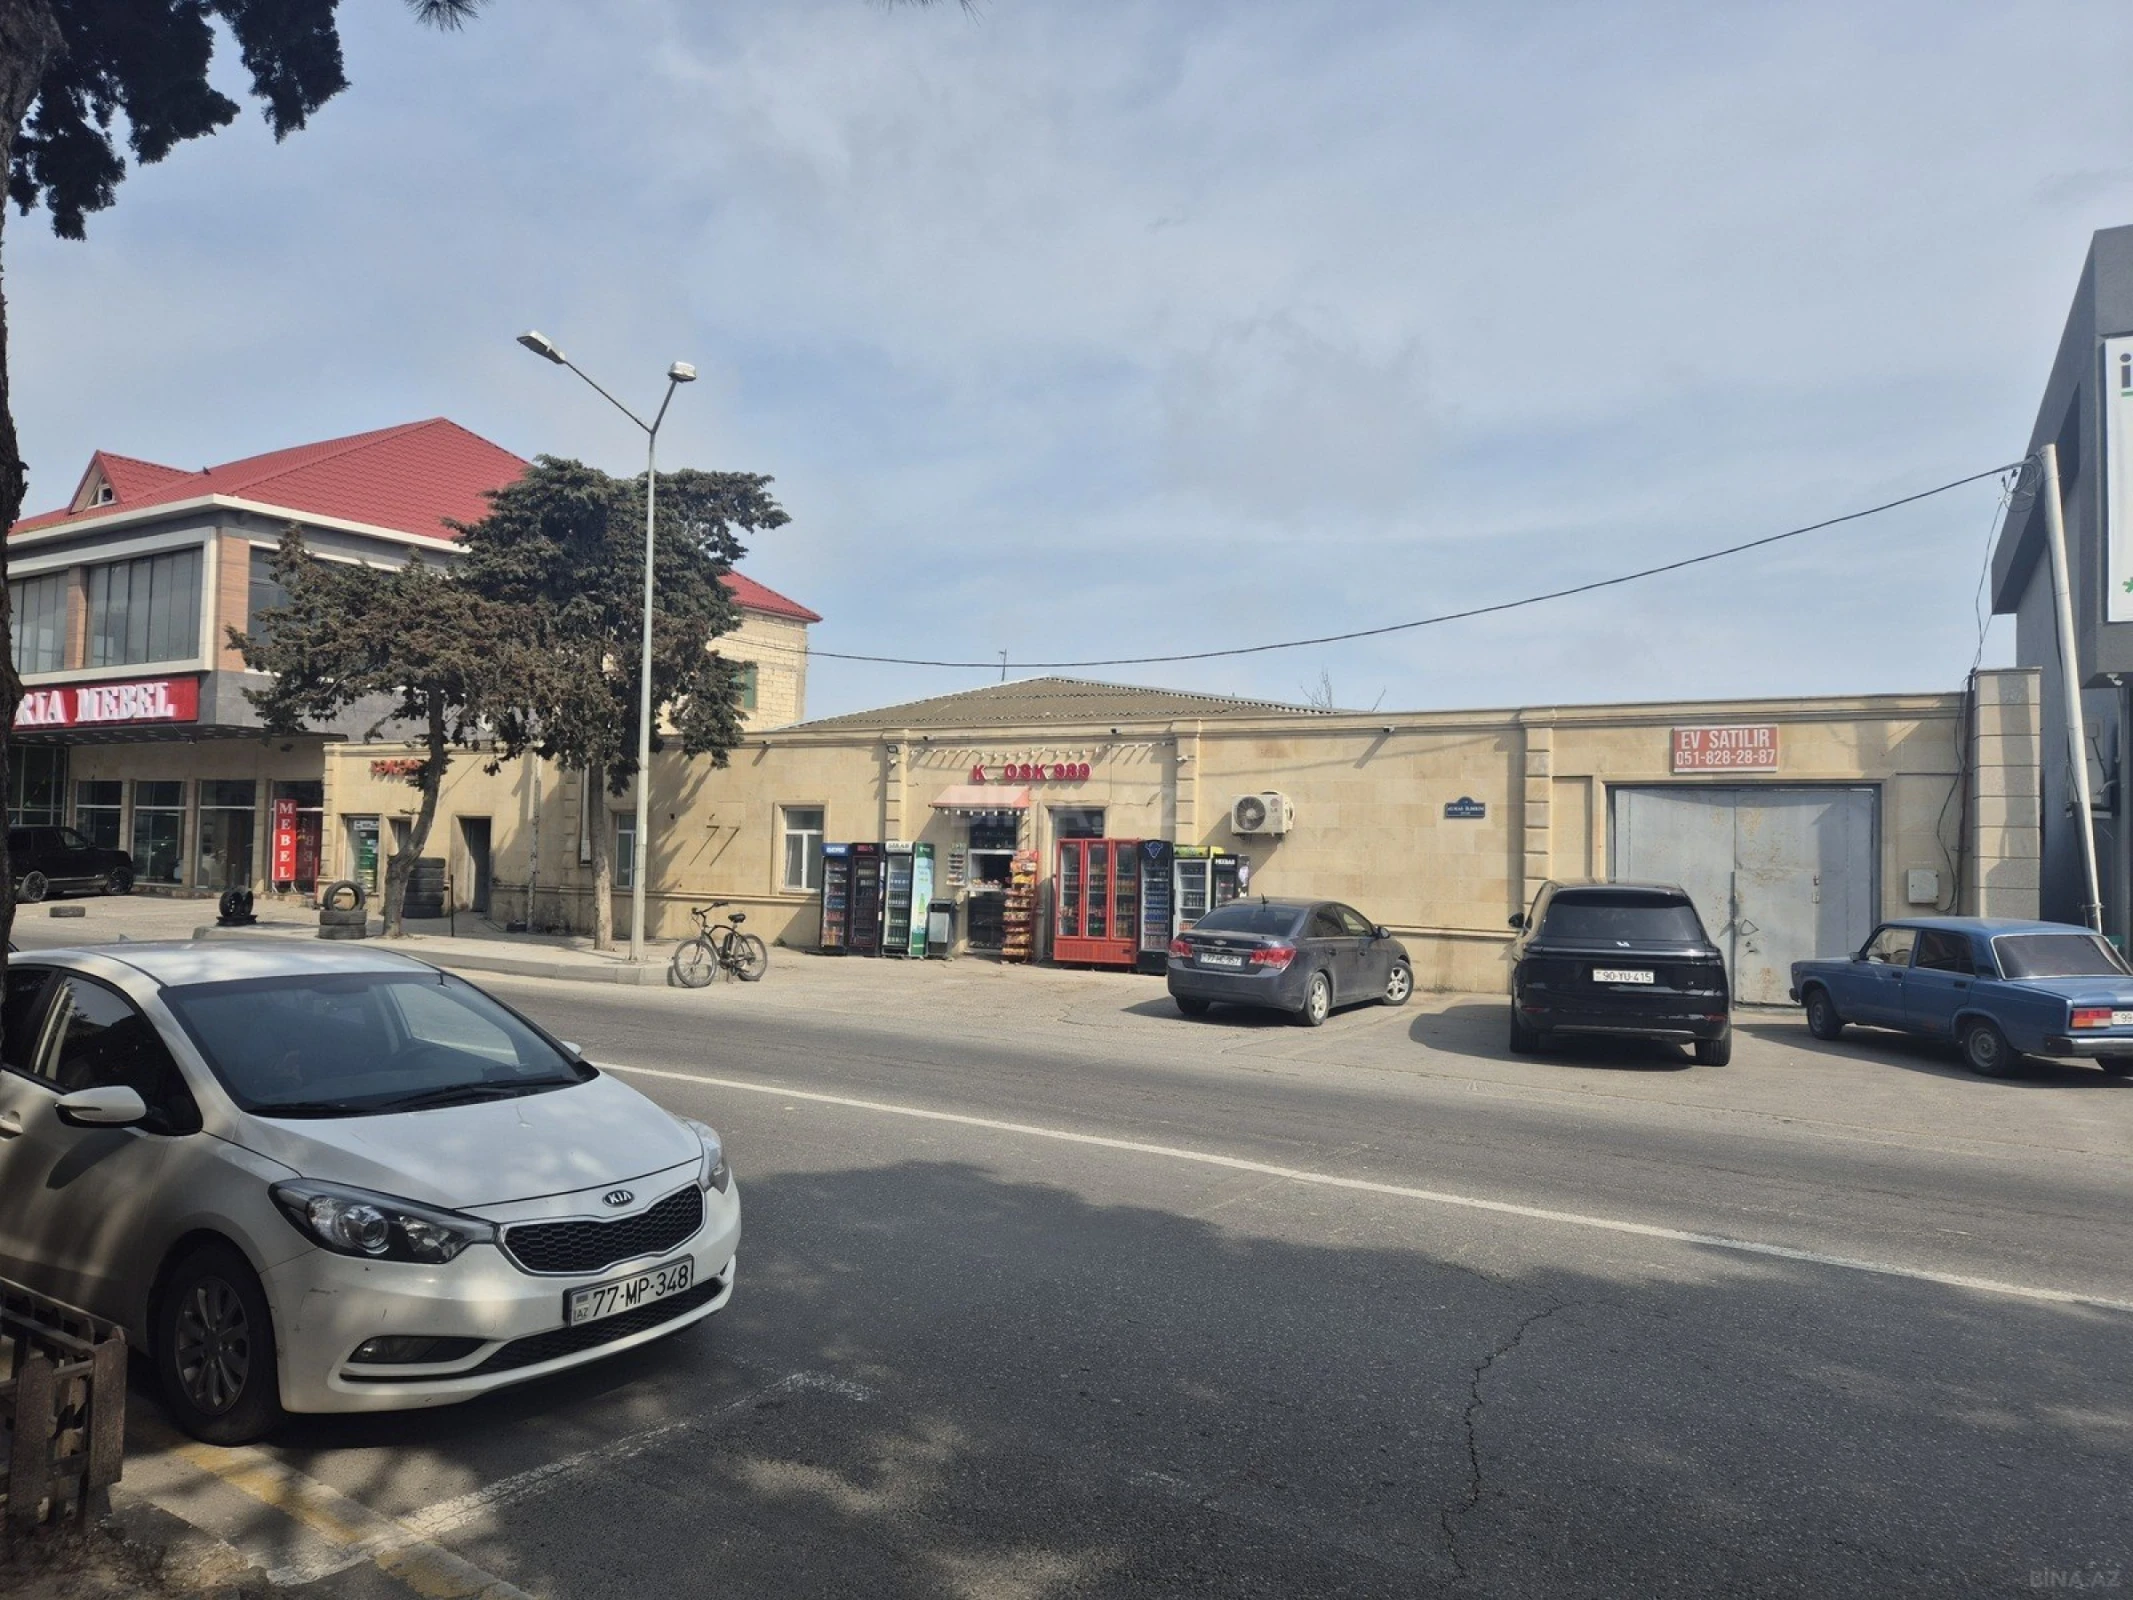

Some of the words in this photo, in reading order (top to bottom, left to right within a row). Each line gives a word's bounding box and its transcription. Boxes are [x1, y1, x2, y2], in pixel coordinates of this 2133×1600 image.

[75, 682, 176, 722] MEBEL
[1681, 730, 1701, 749] EV
[1709, 728, 1770, 749] SATILIR
[1676, 748, 1776, 766] 051-828-28-87
[1054, 762, 1092, 780] 989
[279, 802, 294, 878] MEBEL
[1603, 971, 1652, 982] 90-YU-415
[608, 1191, 632, 1204] KIA
[592, 1264, 689, 1317] 77-MP-348
